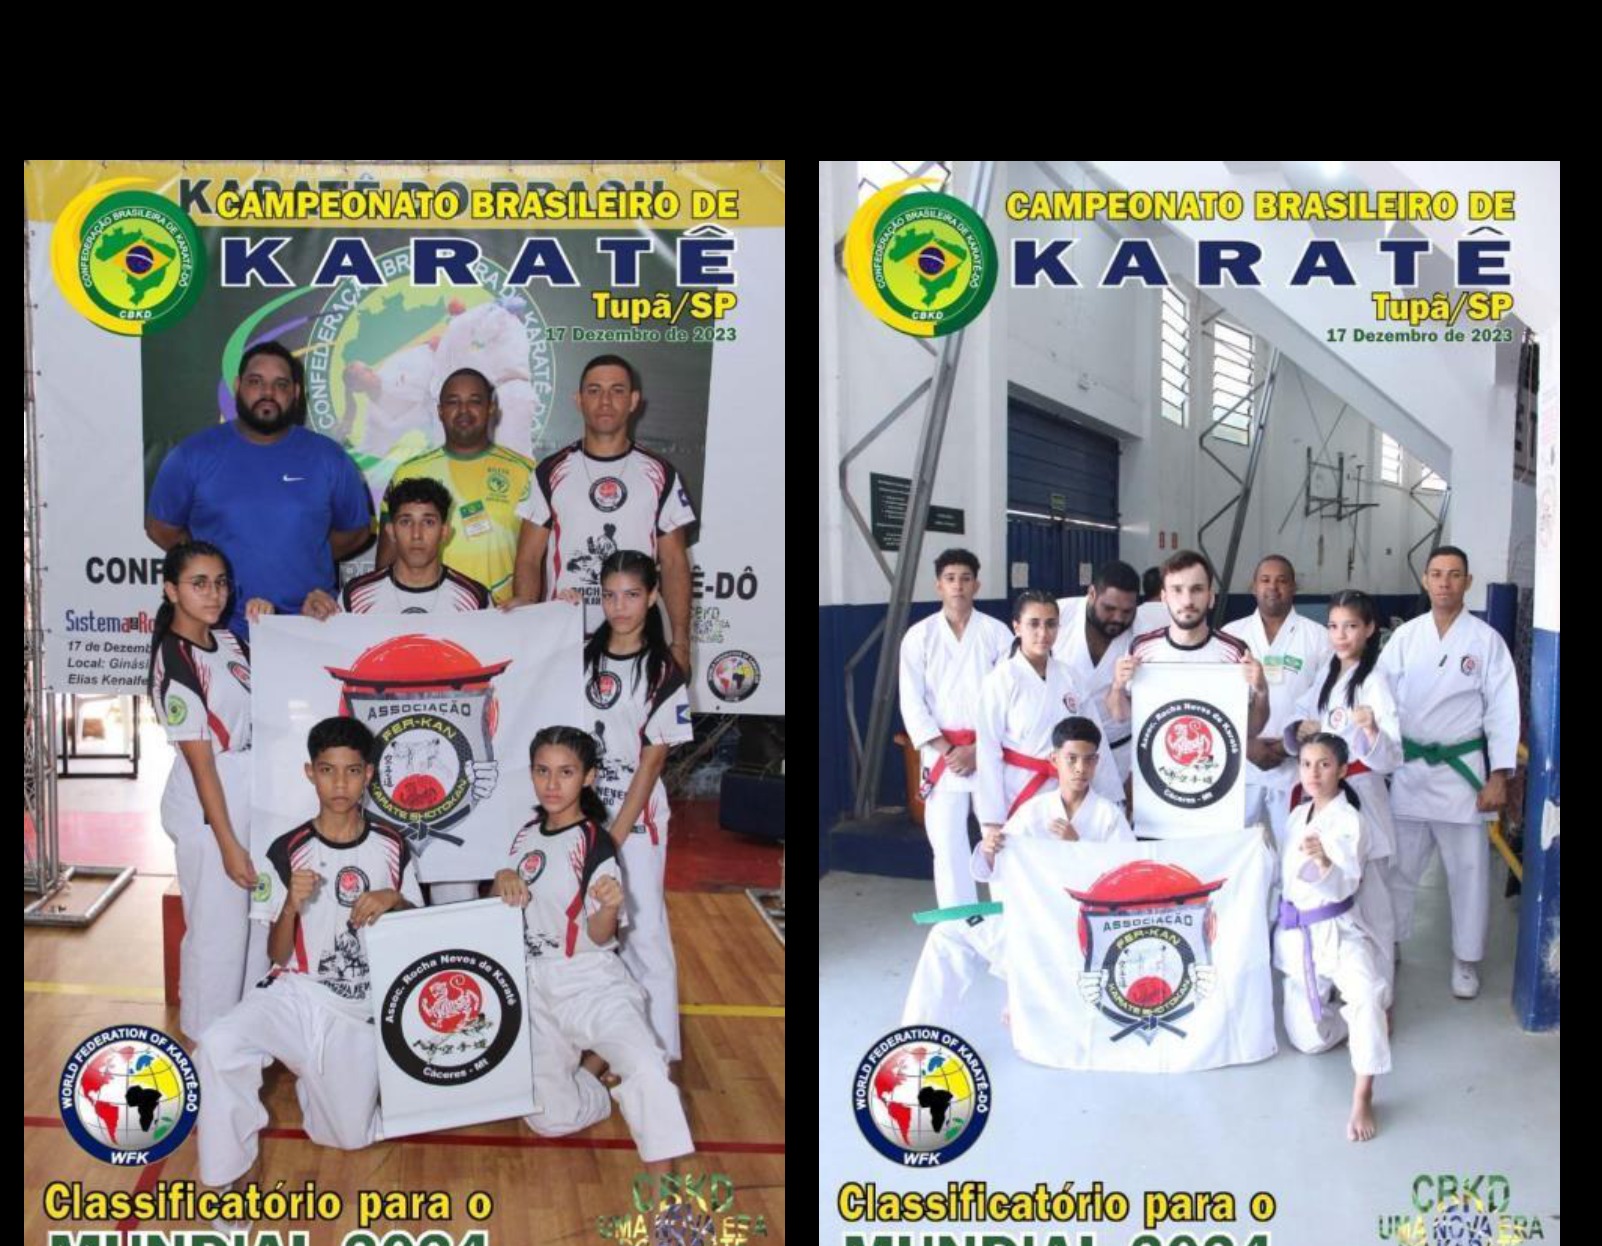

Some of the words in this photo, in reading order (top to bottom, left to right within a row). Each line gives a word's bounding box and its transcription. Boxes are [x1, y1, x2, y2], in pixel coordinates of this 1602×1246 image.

[65, 609, 131, 633] Sistema
[68, 641, 82, 652] 17
[85, 642, 100, 652] de
[67, 656, 105, 668] Local:
[68, 673, 98, 685] Elias
[367, 700, 472, 720] ASSOCIAÇÃO
[382, 717, 457, 741] FER-KAN
[409, 779, 468, 821] SHOTOKAN
[1103, 912, 1194, 932] ASSOCIAÇÃO
[402, 959, 438, 985] Rocha
[441, 954, 476, 965] Neves
[479, 960, 492, 973] de
